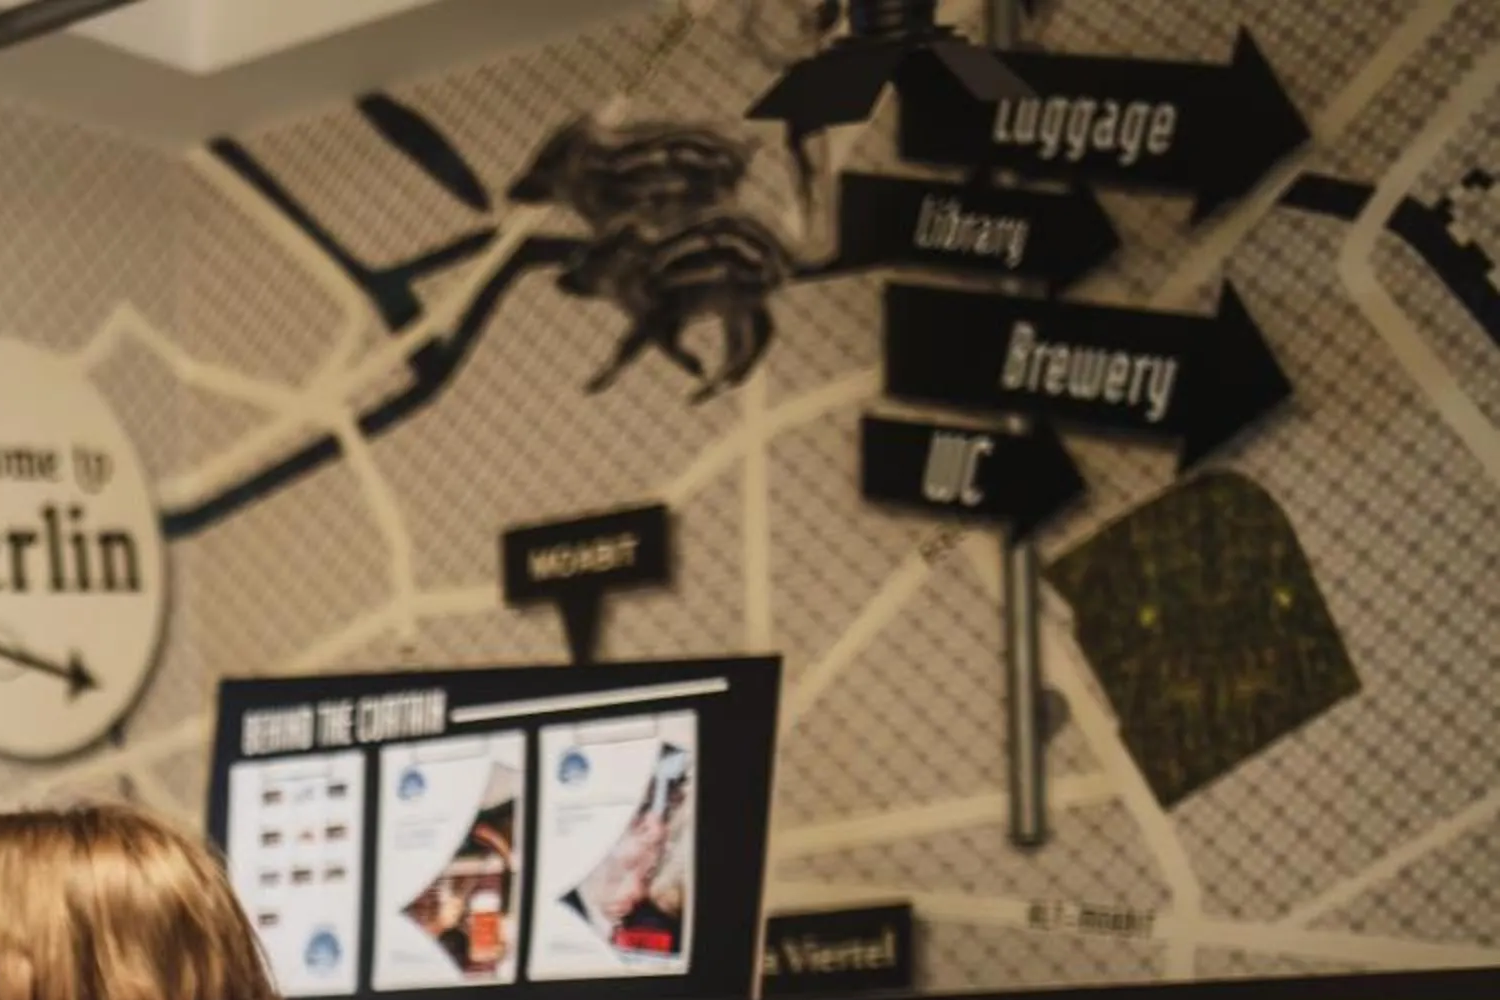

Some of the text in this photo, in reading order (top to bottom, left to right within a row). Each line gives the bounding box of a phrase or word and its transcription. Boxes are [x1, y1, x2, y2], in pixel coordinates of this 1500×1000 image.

[993, 96, 1177, 167] Luggage
[914, 193, 1030, 269] Library
[1002, 320, 1178, 423] Brewery
[923, 431, 994, 506] WC
[782, 926, 896, 974] Viertel
